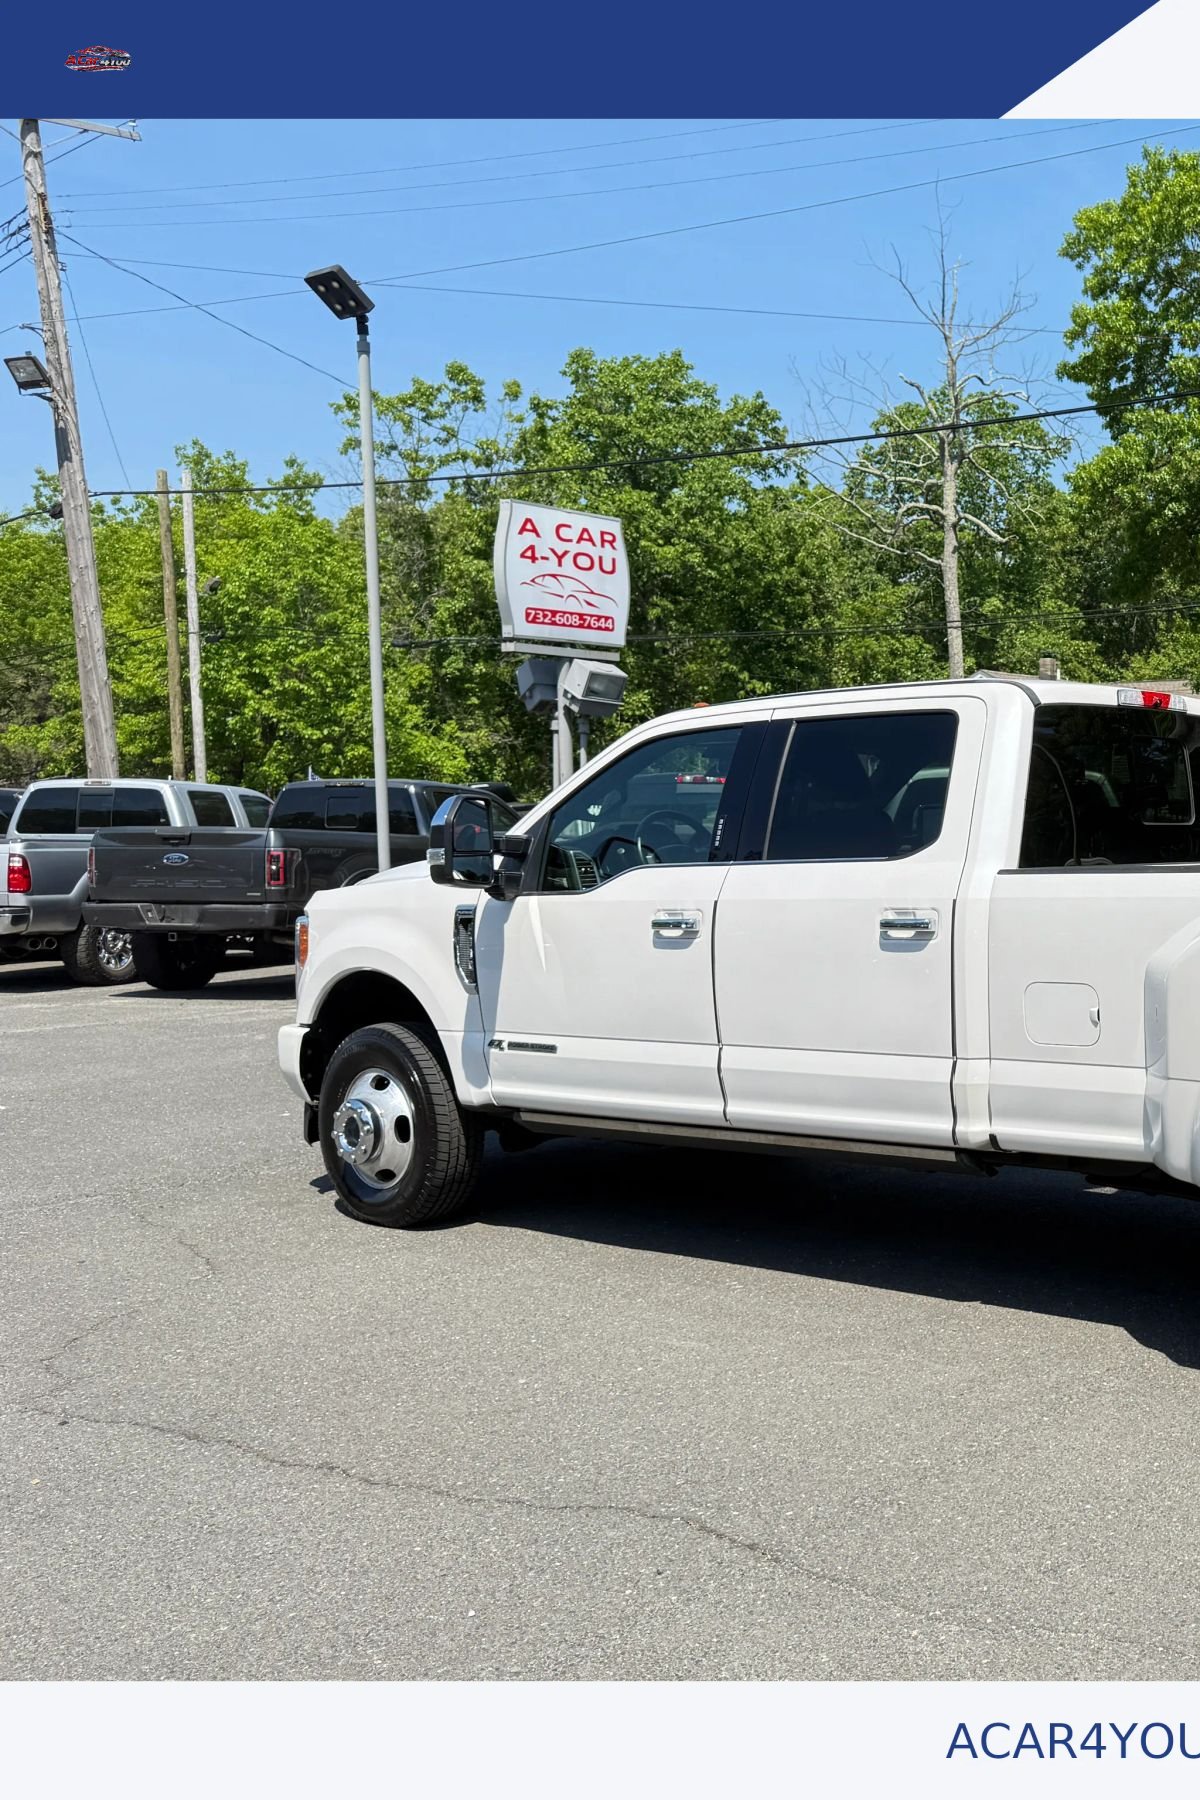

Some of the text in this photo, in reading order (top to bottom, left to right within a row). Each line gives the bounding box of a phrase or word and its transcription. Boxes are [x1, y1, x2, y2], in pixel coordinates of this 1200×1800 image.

[518, 517, 617, 551] A CAR
[519, 544, 617, 575] 4-YOU
[526, 609, 613, 630] 732-608-7644
